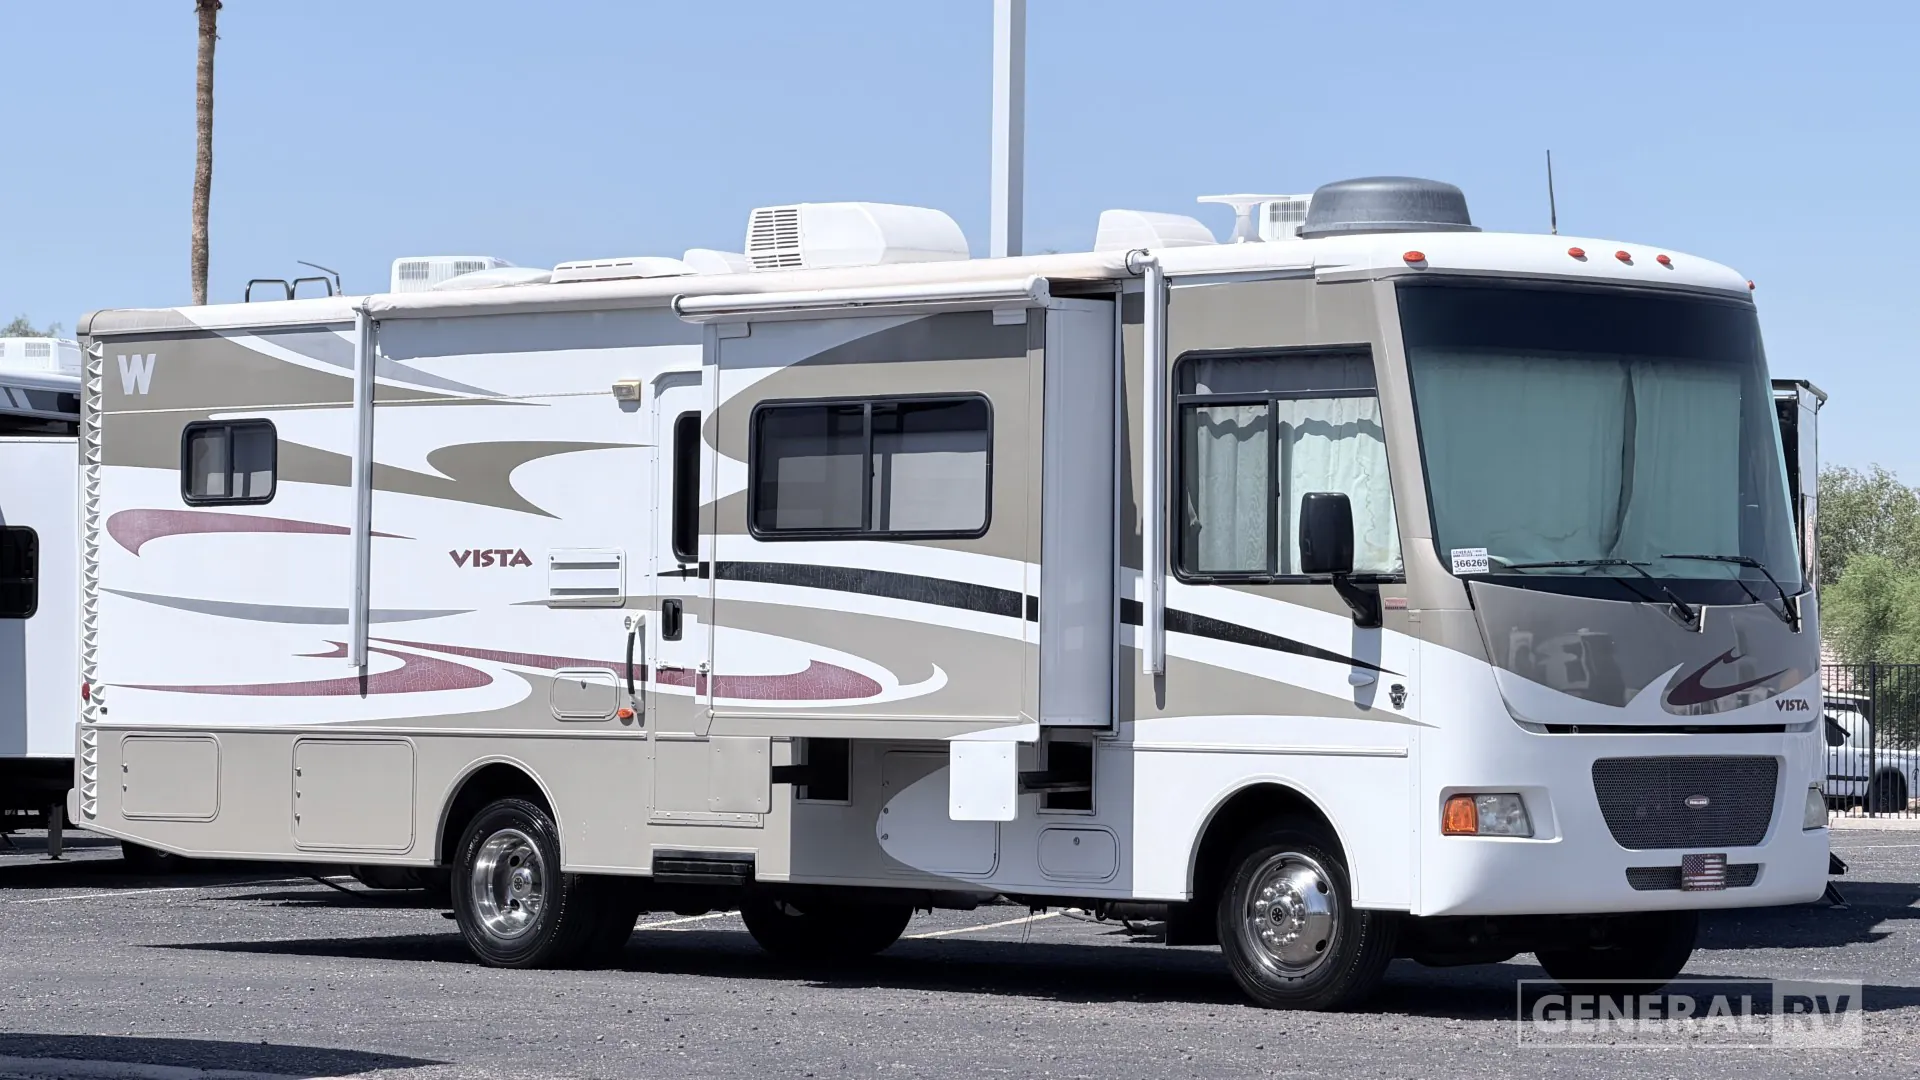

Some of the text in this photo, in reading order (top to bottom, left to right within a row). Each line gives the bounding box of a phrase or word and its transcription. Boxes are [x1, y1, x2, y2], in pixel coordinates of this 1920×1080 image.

[449, 548, 533, 568] VISTA
[1454, 559, 1488, 568] 366269
[1775, 699, 1809, 712] VISTA
